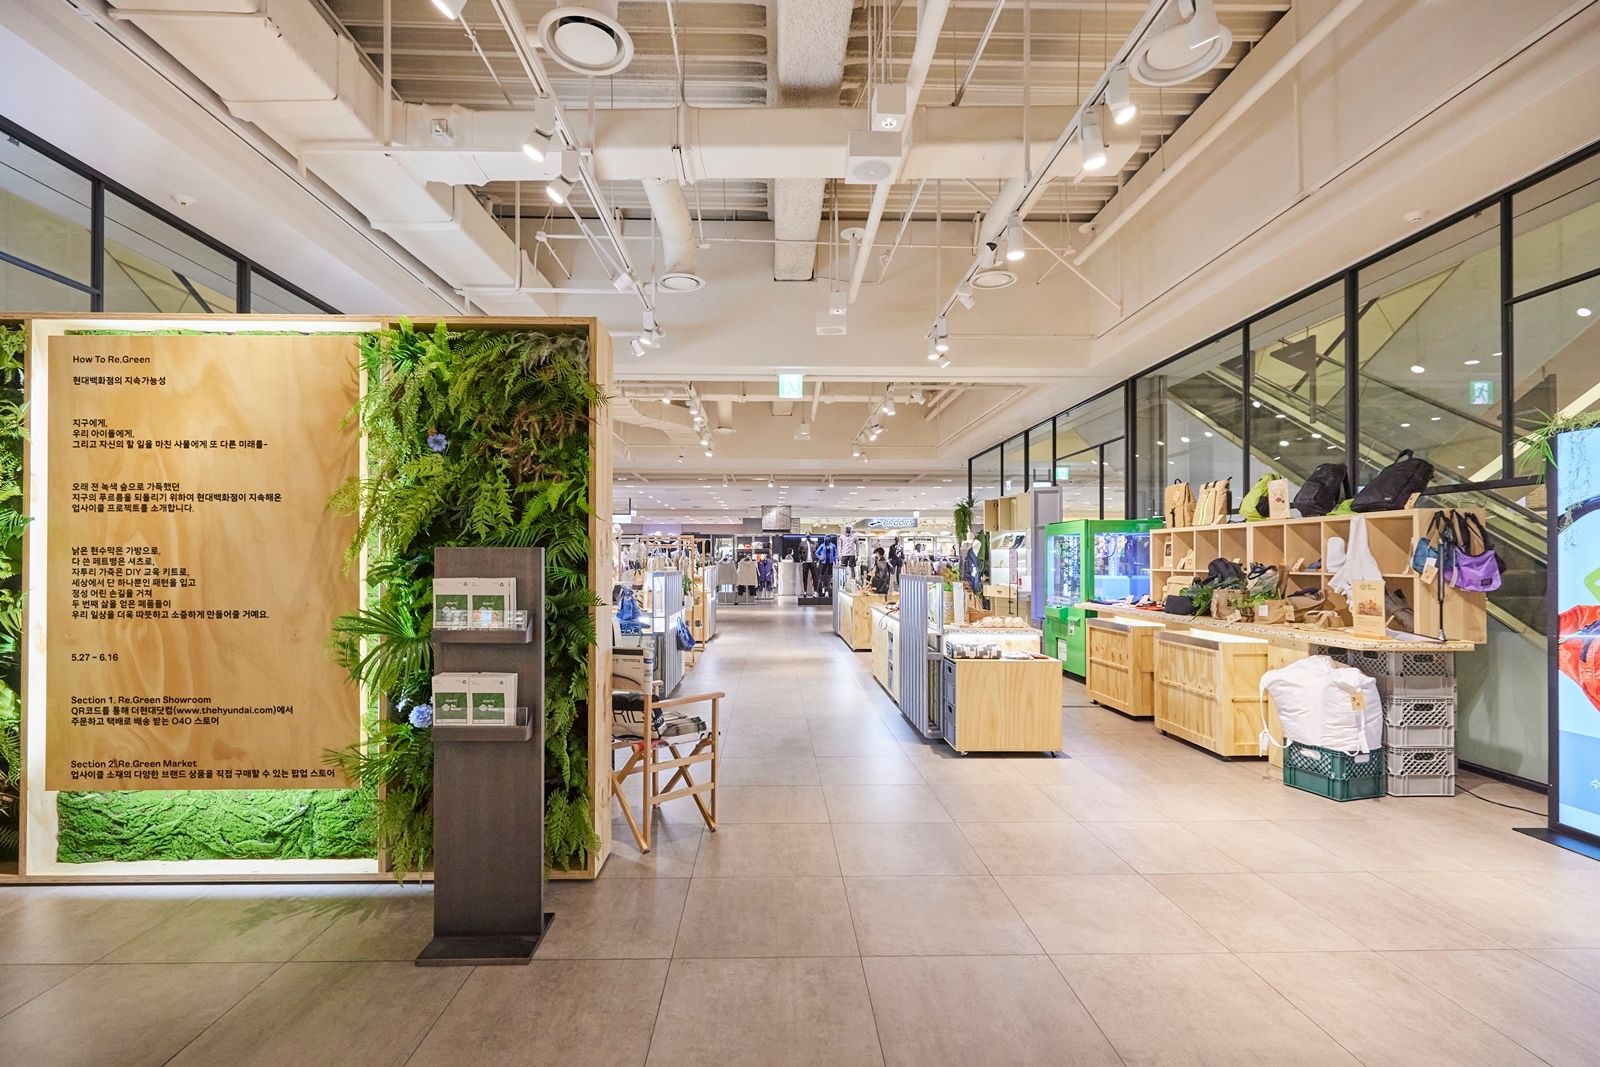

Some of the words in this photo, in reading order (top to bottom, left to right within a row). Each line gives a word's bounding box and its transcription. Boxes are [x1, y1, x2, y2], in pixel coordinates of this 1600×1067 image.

[72, 355, 93, 364] How
[94, 355, 106, 364] To
[107, 355, 150, 364] Re.Green
[72, 375, 122, 386] 현대백화점의
[124, 376, 166, 386] 지속가능성
[72, 418, 108, 428] 지구에게,
[72, 429, 89, 439] 우리
[90, 429, 135, 439] 아이들에게,
[72, 440, 97, 449] 그리고
[99, 439, 124, 450] 자신의
[126, 439, 135, 449] 할
[136, 439, 153, 449] 일을
[155, 439, 172, 449] 마친
[173, 439, 208, 449] 사물에게
[209, 440, 218, 449] 또
[219, 440, 237, 449] 다른
[72, 482, 89, 492] 오래
[90, 482, 99, 492] 전
[101, 482, 118, 492] 녹색
[119, 482, 145, 492] 숲으로
[146, 482, 180, 492] 가득했던
[72, 493, 97, 502] 지구의
[98, 493, 132, 503] 푸르름을
[134, 493, 167, 502] 되돌리기
[169, 493, 194, 502] 위하여
[196, 492, 247, 503] 현대백화점이
[248, 493, 282, 502] 지속해온
[71, 503, 105, 513] 업사이클
[107, 503, 148, 513] 프로젝트를
[150, 503, 194, 513] 소개합니다.
[881, 519, 915, 527] BROOKS
[71, 546, 88, 556] 낡은
[90, 546, 124, 556] 현수막은
[125, 546, 161, 556] 가방으로,
[71, 557, 81, 566] 다
[82, 557, 91, 567] 쓴
[92, 556, 126, 567] 페트병은
[127, 557, 155, 566] 셔츠로,
[71, 567, 96, 577] 자투리
[99, 567, 124, 577] 가죽은
[125, 568, 142, 576] DIY
[143, 567, 160, 577] 교육
[162, 567, 190, 577] 키트로,
[71, 578, 105, 588] 세상에서
[106, 578, 115, 588] 단
[117, 578, 150, 588] 하나뿐인
[152, 578, 177, 588] 패턴을
[179, 578, 196, 588] 입고
[71, 589, 88, 599] 정성
[90, 589, 107, 599] 어린
[109, 588, 134, 599] 손길을
[136, 588, 153, 598] 거쳐
[71, 599, 80, 609] 두
[82, 599, 99, 609] 번째
[100, 599, 117, 609] 삶을
[119, 599, 136, 609] 얻은
[137, 599, 171, 609] 폐품들이
[71, 610, 88, 620] 우리
[90, 610, 115, 620] 일상을
[117, 610, 134, 620] 더욱
[135, 610, 169, 620] 따뜻하고
[171, 610, 205, 620] 소중하게
[206, 610, 240, 620] 만들어줄
[242, 610, 270, 619] 거예요.
[71, 653, 90, 662] 5.27
[99, 653, 119, 662] 6.16
[71, 696, 106, 704] Section
[108, 696, 116, 704] 1.
[118, 696, 161, 704] Re.Green
[162, 695, 211, 704] Showroom
[71, 706, 110, 716] QR코드를
[112, 706, 129, 716] 통해
[131, 705, 293, 716] 더현대닷컴(www.thehyundai.com)에서
[71, 717, 105, 727] 주문하고
[106, 717, 132, 726] 택배로
[133, 717, 151, 726] 배송
[152, 717, 170, 726] 받는
[194, 716, 219, 725] 스토어
[70, 760, 106, 769] Section
[118, 759, 162, 769] Re.Green
[162, 759, 198, 769] Market
[70, 770, 104, 780] 업사이클
[106, 769, 132, 779] 소재의
[134, 770, 159, 779] 다양한
[161, 770, 186, 779] 브랜드
[188, 769, 214, 779] 상품을
[216, 769, 233, 779] 직접
[234, 769, 260, 779] 구매할
[262, 769, 270, 779] 수
[272, 769, 289, 779] 있는
[291, 769, 308, 778] 팝업
[310, 769, 335, 778] 스토어
